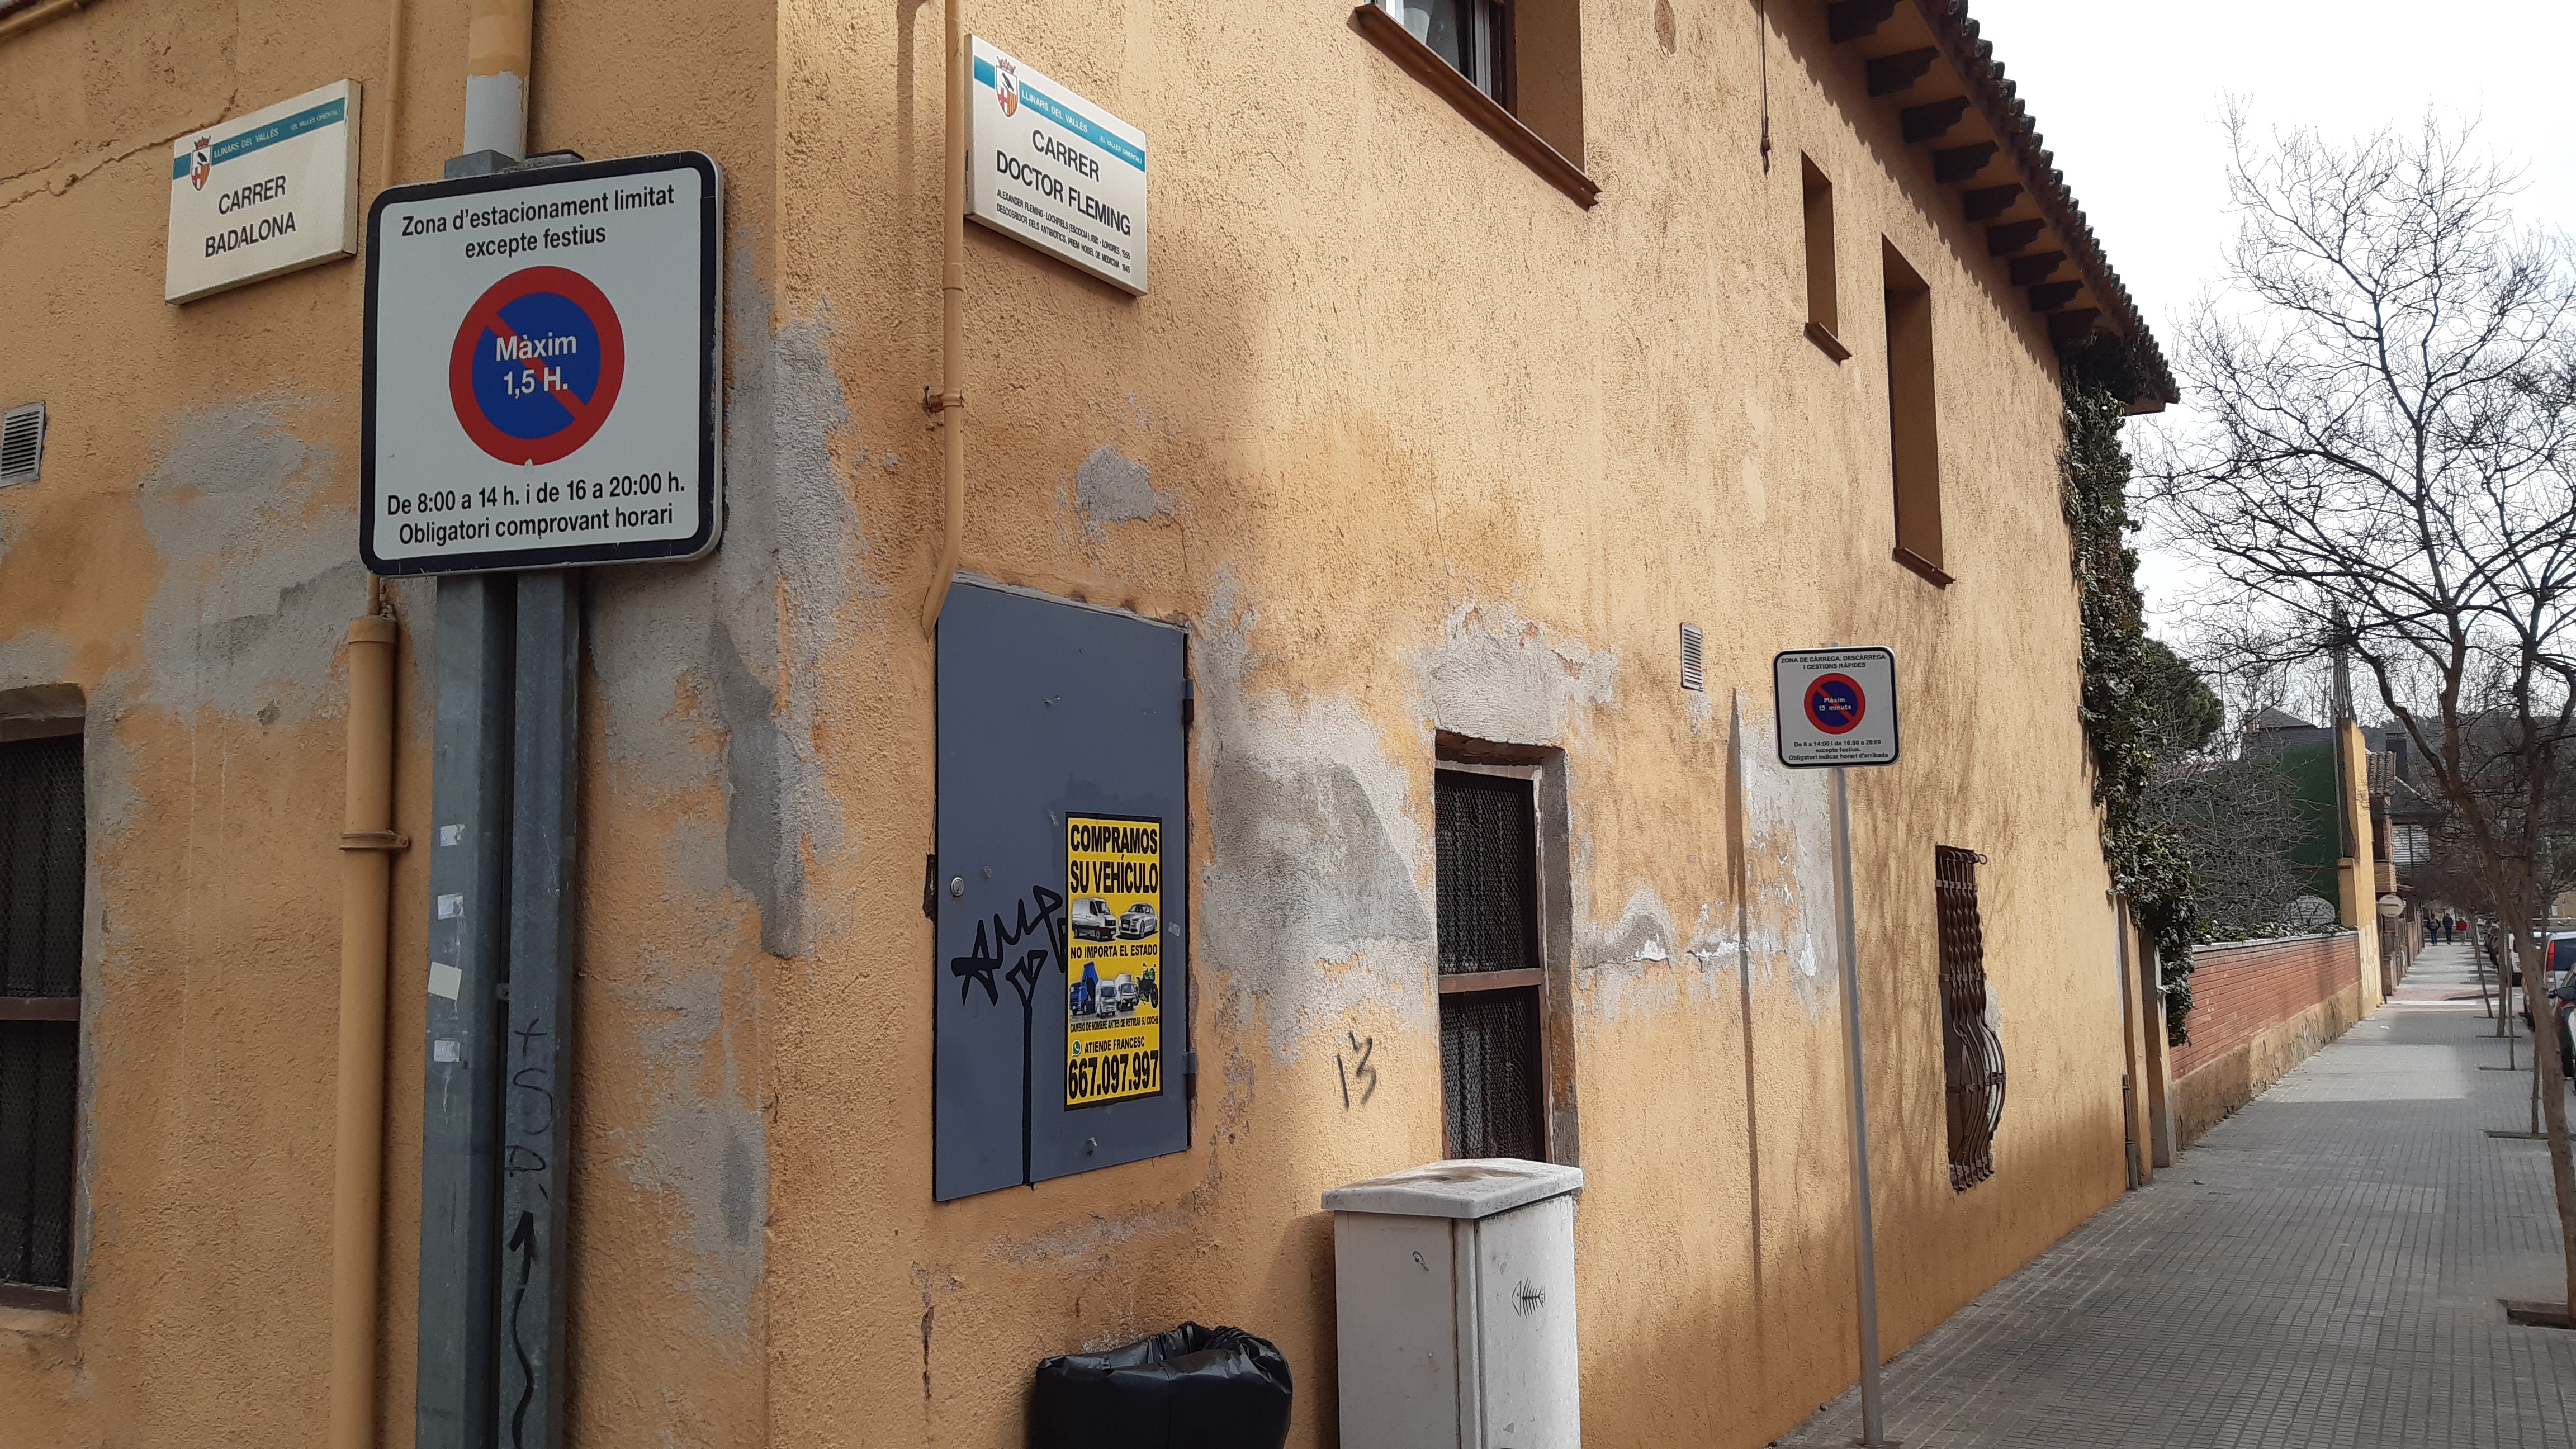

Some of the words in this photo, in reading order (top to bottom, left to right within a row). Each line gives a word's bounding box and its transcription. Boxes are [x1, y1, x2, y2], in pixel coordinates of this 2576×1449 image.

[1022, 89, 1049, 111] LLINARS
[1051, 106, 1063, 120] DEL
[214, 142, 239, 158] LLINARS
[242, 138, 253, 148] DEL
[1032, 130, 1100, 183] CARRER
[219, 174, 287, 215] CARRER
[401, 215, 447, 237] Zona
[453, 192, 609, 230] d'estacionament
[614, 184, 675, 210] limitat
[997, 150, 1063, 203] DOCTOR
[1068, 186, 1130, 237] FLEMING
[997, 188, 1024, 209] ALEXANDER
[1025, 201, 1044, 218] FLEMING
[205, 211, 296, 258] BADALONA
[465, 231, 538, 259] excepte
[543, 225, 606, 249] festius
[997, 203, 1027, 225] DESCOBRIDOR
[1029, 218, 1040, 231] DELS
[1068, 237, 1080, 250] PREMI
[1081, 243, 1094, 257] NOBEL
[1095, 250, 1101, 259] DE
[1102, 253, 1120, 268] MEDICINA
[1122, 263, 1130, 274] 1945
[495, 332, 577, 362] Màxim
[503, 369, 536, 399] 1,5
[543, 366, 569, 392] H.
[387, 494, 412, 515] De
[417, 490, 456, 513] 8:00
[461, 494, 472, 510] a
[478, 487, 497, 508] 14
[503, 484, 520, 505] h.
[525, 483, 531, 504] i
[536, 481, 560, 503] de
[566, 479, 586, 501] 16
[592, 483, 603, 499] a
[609, 473, 662, 497] 20:00
[668, 471, 685, 493] h.
[399, 517, 490, 546] Obligatori
[495, 508, 610, 538] comprovant
[615, 503, 673, 529] horari
[1071, 824, 1158, 854] COMPRAMOS
[1071, 860, 1089, 893] SU
[1093, 854, 1158, 893] VEHÍCULO
[1071, 946, 1082, 959] NO
[1085, 945, 1117, 958] IMPORTA
[1120, 945, 1129, 956] EL
[1130, 944, 1158, 956] ESTADO
[1070, 1022, 1085, 1033] CAMBIO
[1086, 1021, 1091, 1031] DE
[1092, 1020, 1107, 1030] NOMBRE
[1108, 1019, 1120, 1029] ANTES
[1120, 1018, 1125, 1027] DE
[1126, 1017, 1141, 1027] RETIRAR
[1142, 1016, 1146, 1025] SU
[1147, 1015, 1158, 1025] COCHE
[1085, 1040, 1111, 1054] ATIENDE
[1113, 1036, 1145, 1050] FRANCESC
[1068, 1050, 1159, 1100] 667.097.997
